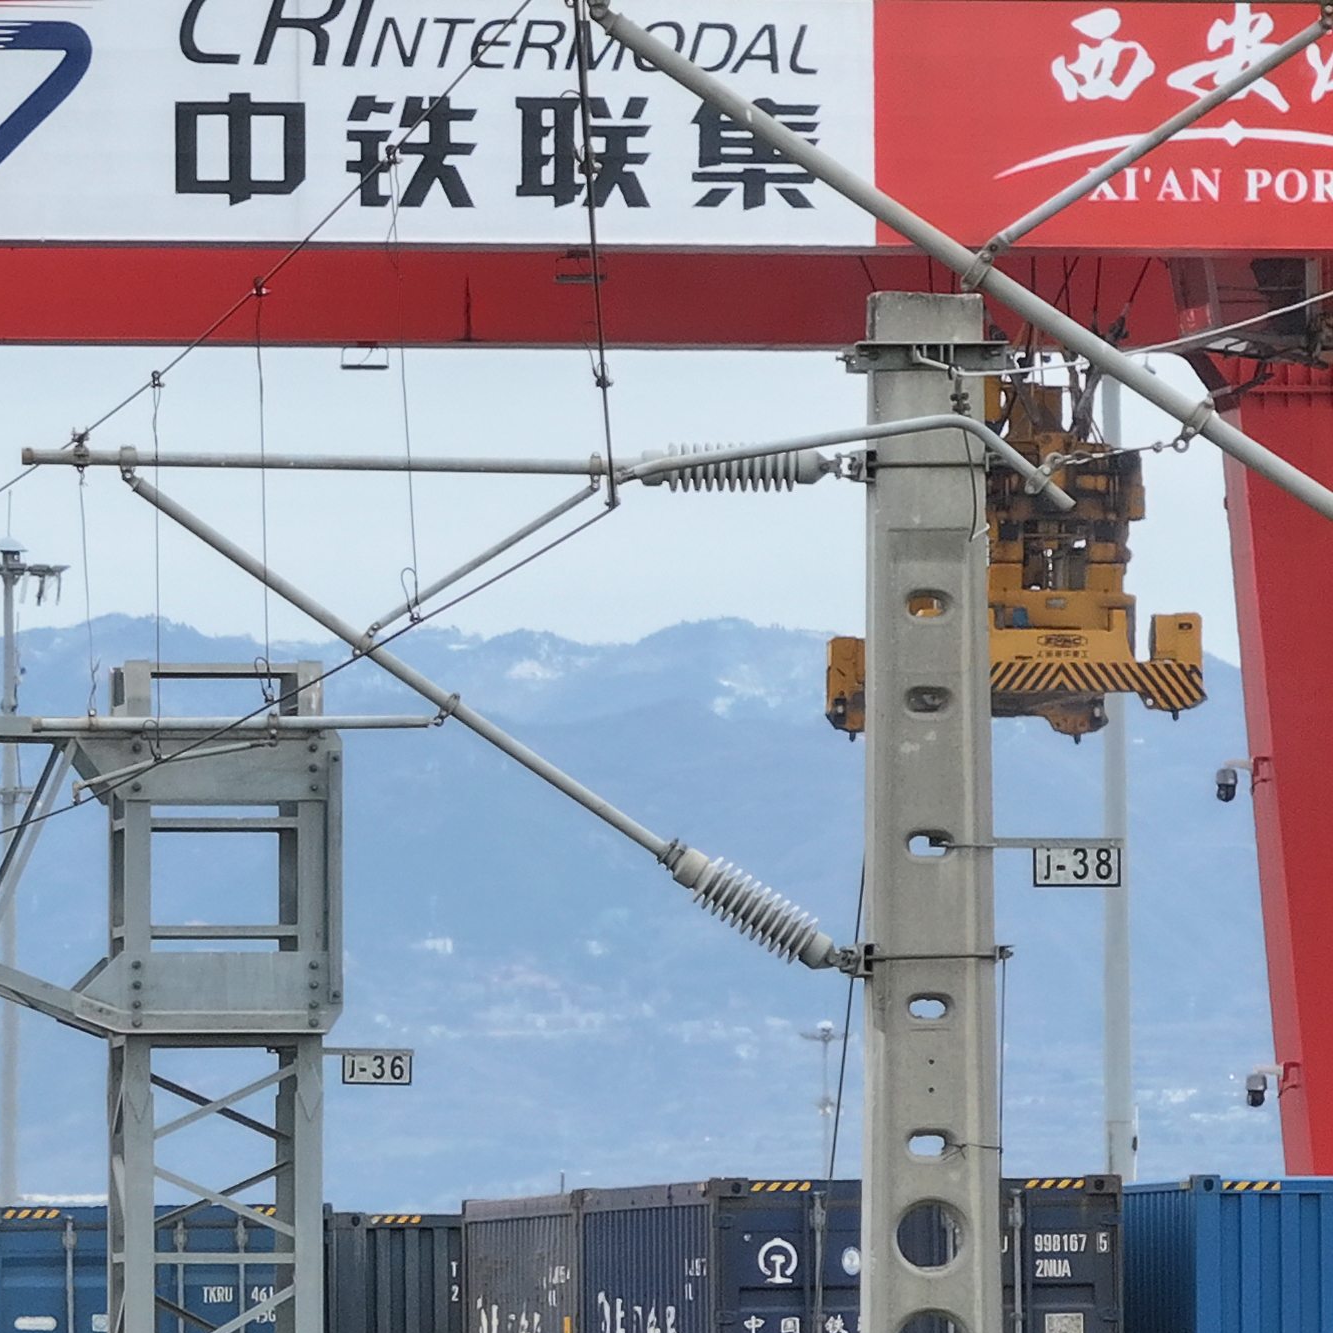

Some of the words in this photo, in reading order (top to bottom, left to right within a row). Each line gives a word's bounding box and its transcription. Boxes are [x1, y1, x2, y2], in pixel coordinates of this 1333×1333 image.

[174, 92, 821, 211] 中铁联集
[1034, 1233, 1088, 1253] 998167
[1035, 1259, 1072, 1278] 2NUA
[202, 1285, 234, 1304] TKRU
